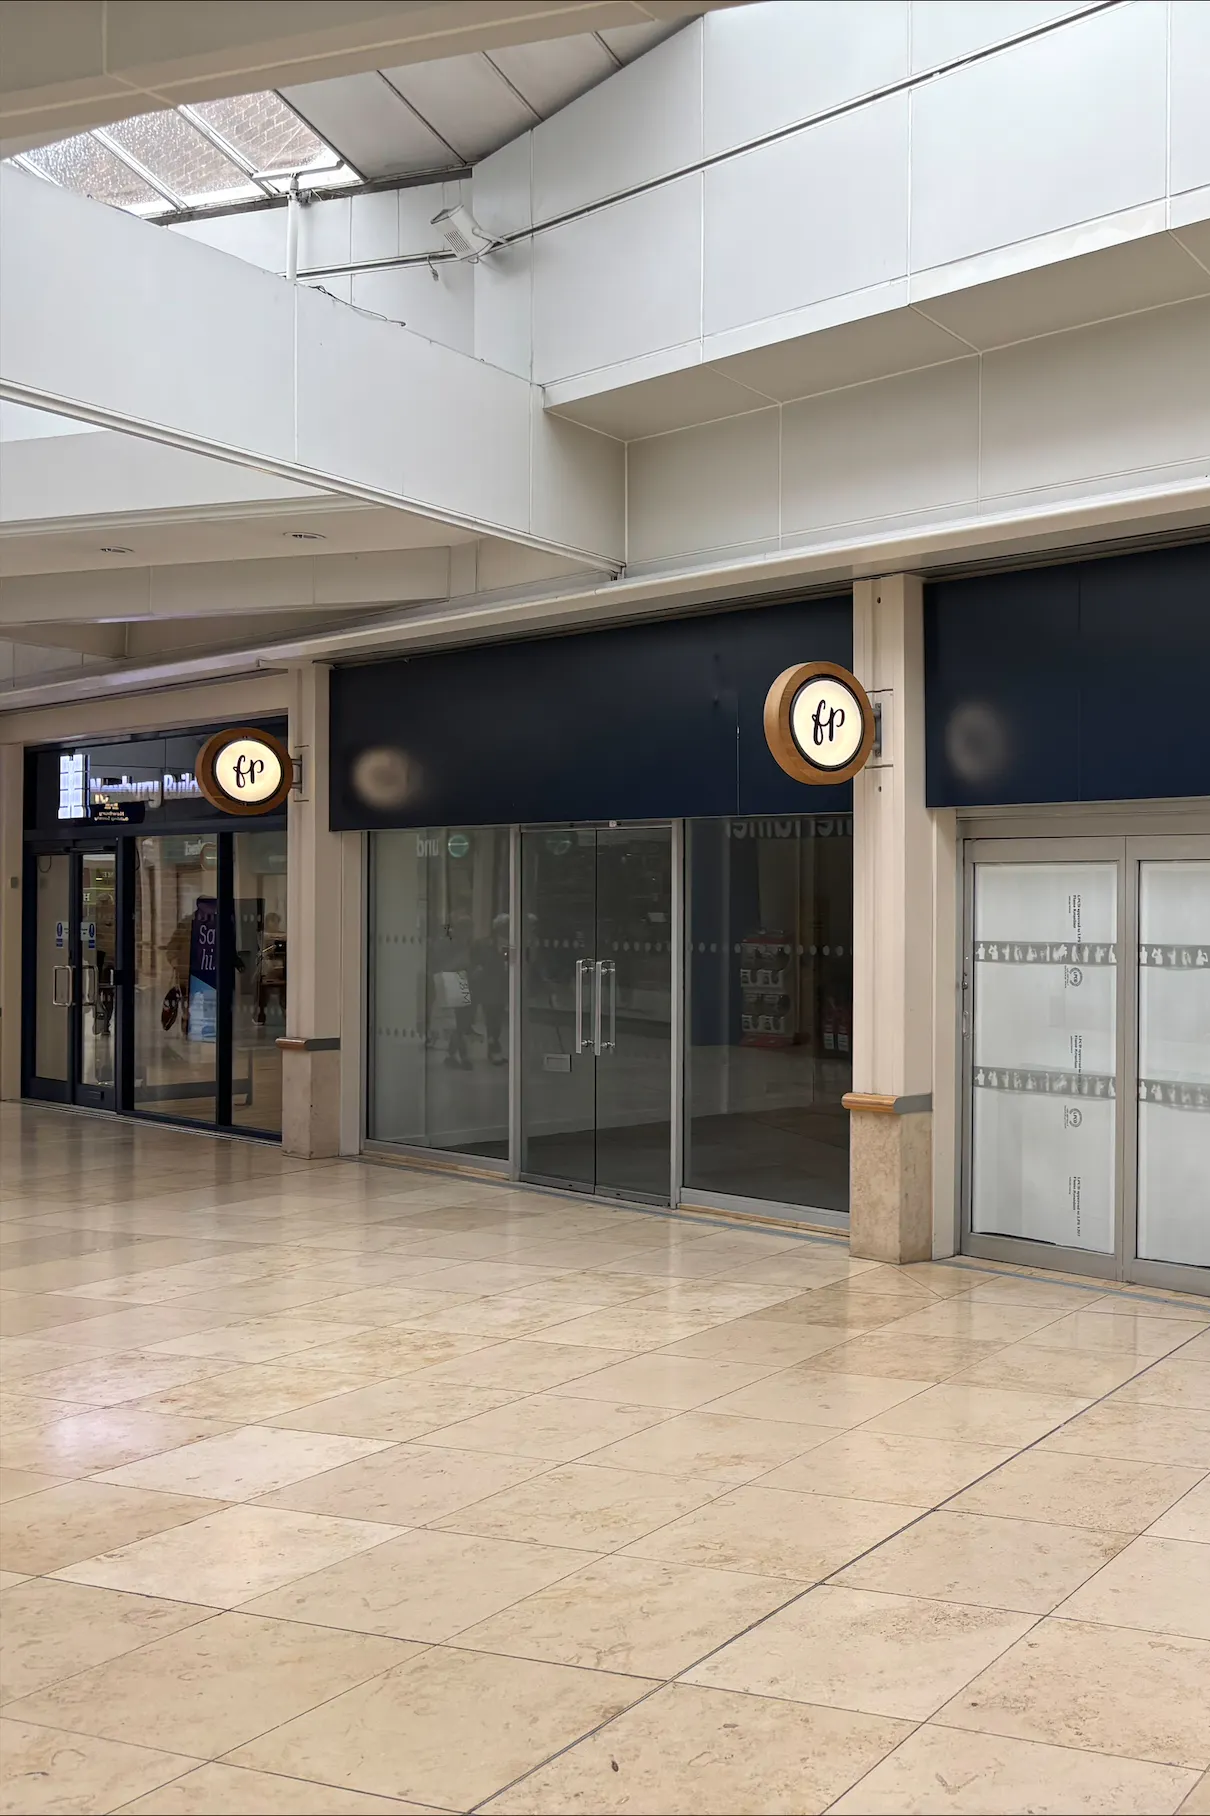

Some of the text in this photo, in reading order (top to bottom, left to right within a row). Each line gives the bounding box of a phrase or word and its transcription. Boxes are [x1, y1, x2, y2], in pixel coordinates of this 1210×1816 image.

[812, 700, 845, 746] fp
[233, 755, 264, 788] fp
[199, 925, 216, 945] Sa
